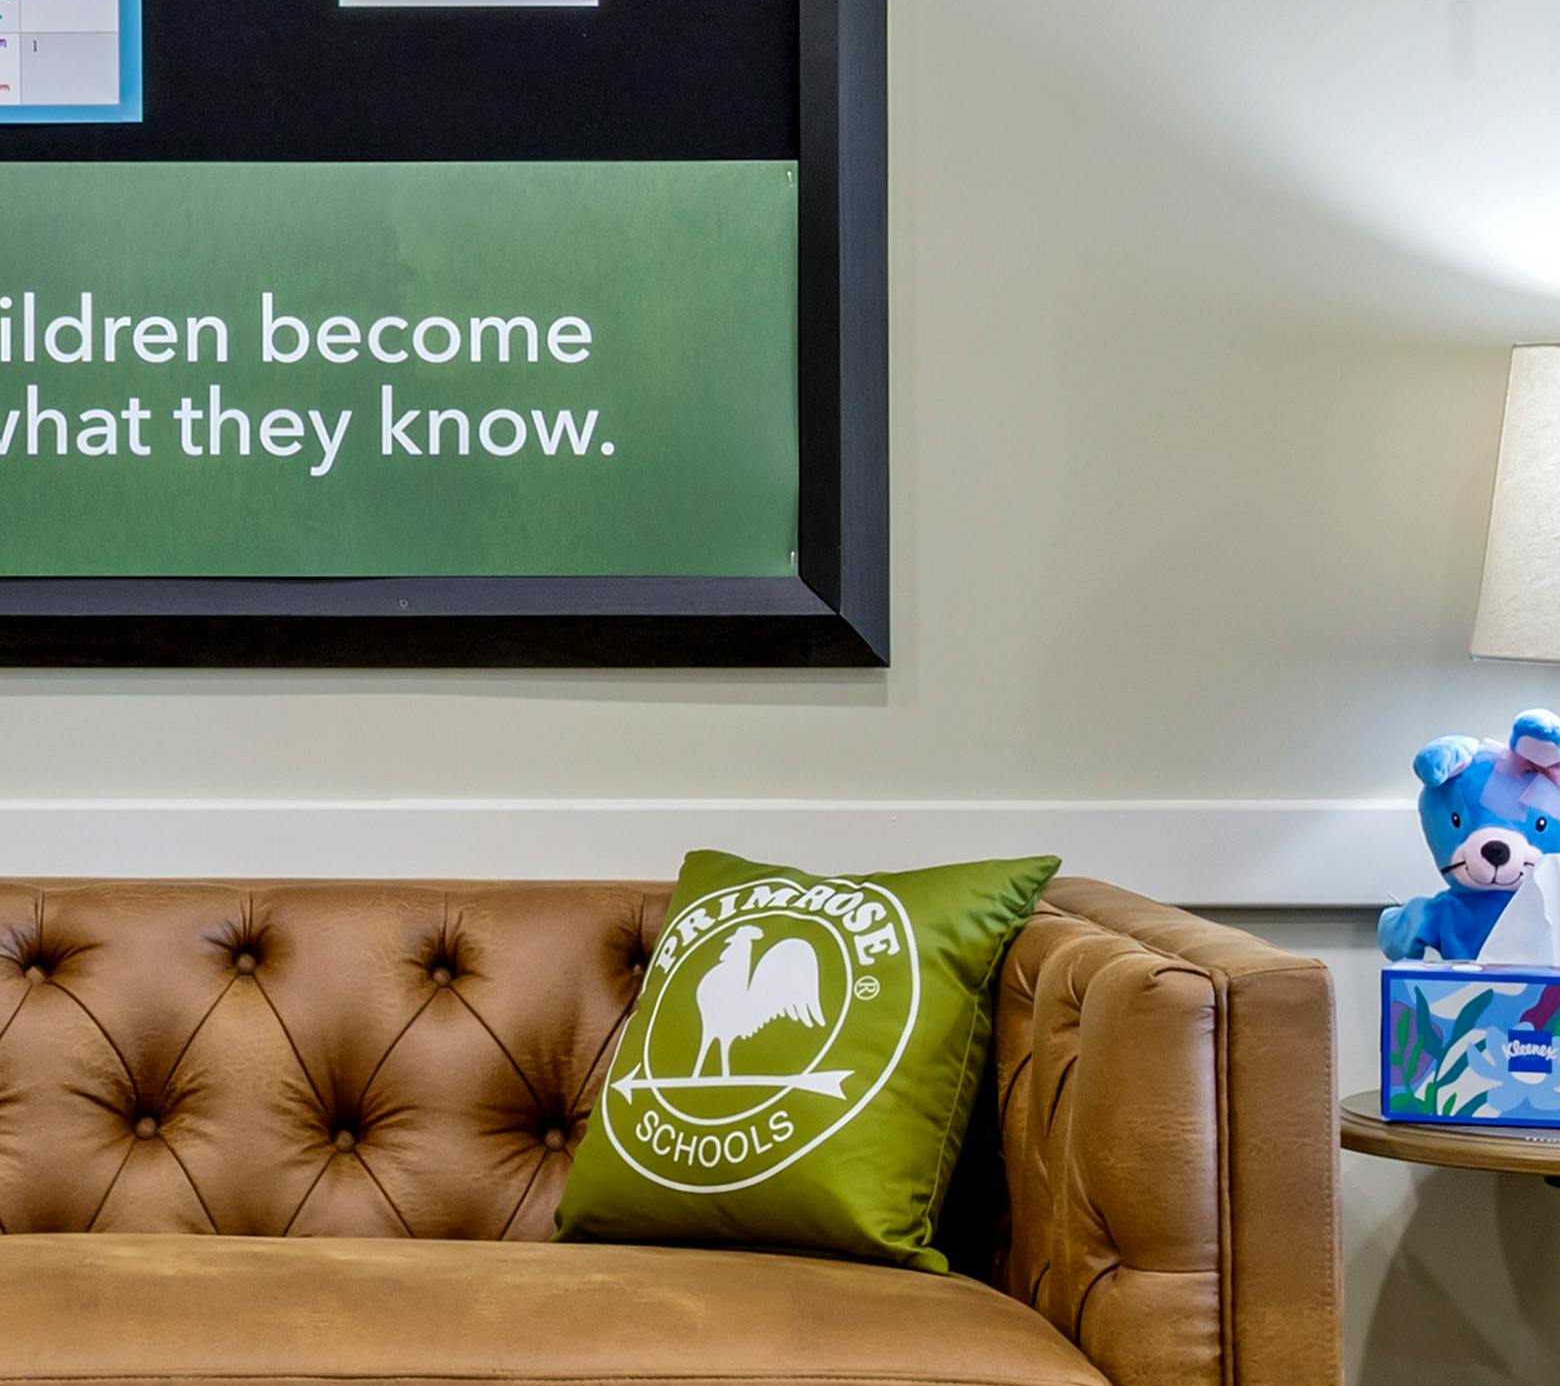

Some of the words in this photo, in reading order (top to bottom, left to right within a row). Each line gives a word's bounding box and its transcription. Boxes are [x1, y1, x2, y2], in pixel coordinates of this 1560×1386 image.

[261, 292, 593, 363] become
[173, 384, 352, 476] they
[381, 384, 615, 456] know.
[1501, 1039, 1559, 1061] Kleenex
[635, 1109, 794, 1168] SCHOOLS
